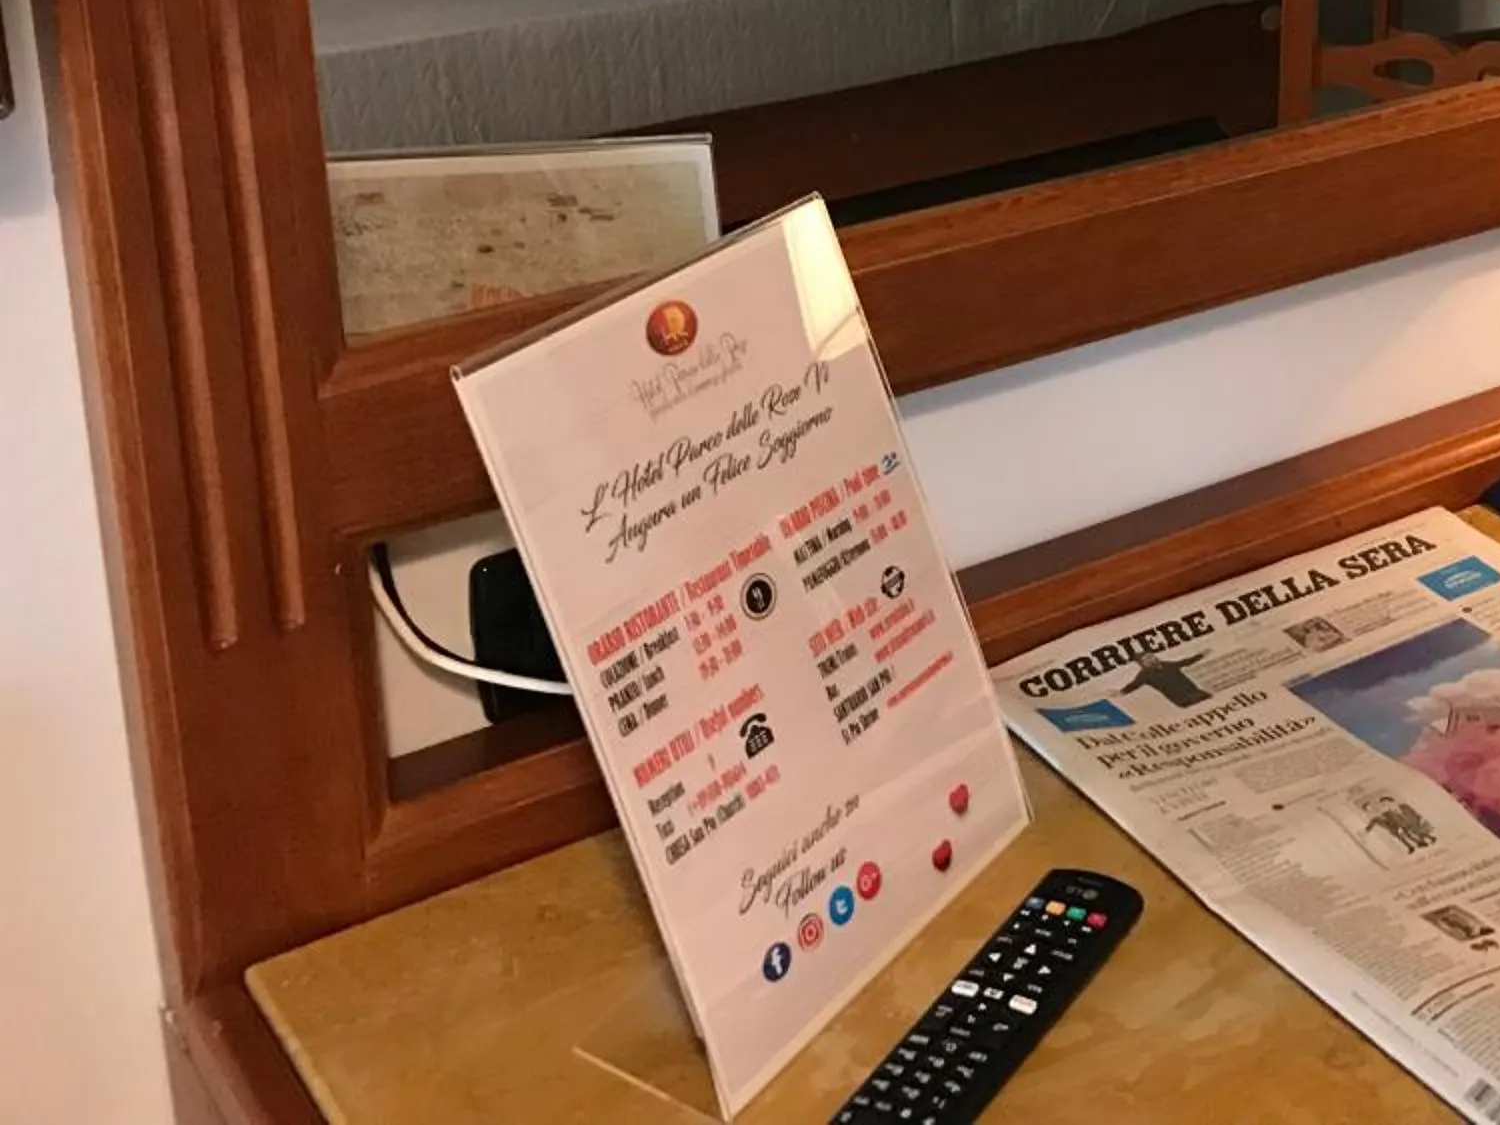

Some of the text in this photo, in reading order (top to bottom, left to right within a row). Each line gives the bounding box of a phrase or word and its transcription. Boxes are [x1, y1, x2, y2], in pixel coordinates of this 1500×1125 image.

[611, 451, 664, 508] Hotel
[664, 435, 723, 476] Parco
[725, 403, 760, 441] delle
[760, 382, 802, 421] Rose
[803, 360, 830, 394] Vi
[604, 407, 834, 564] Augura un Felice Soggiorno
[1019, 610, 1216, 699] CORRIERE
[1215, 568, 1340, 626] DELLA
[1338, 533, 1437, 580] SERA
[1157, 717, 1256, 757] governo
[1183, 689, 1268, 732] appello
[775, 866, 826, 920] Follow
